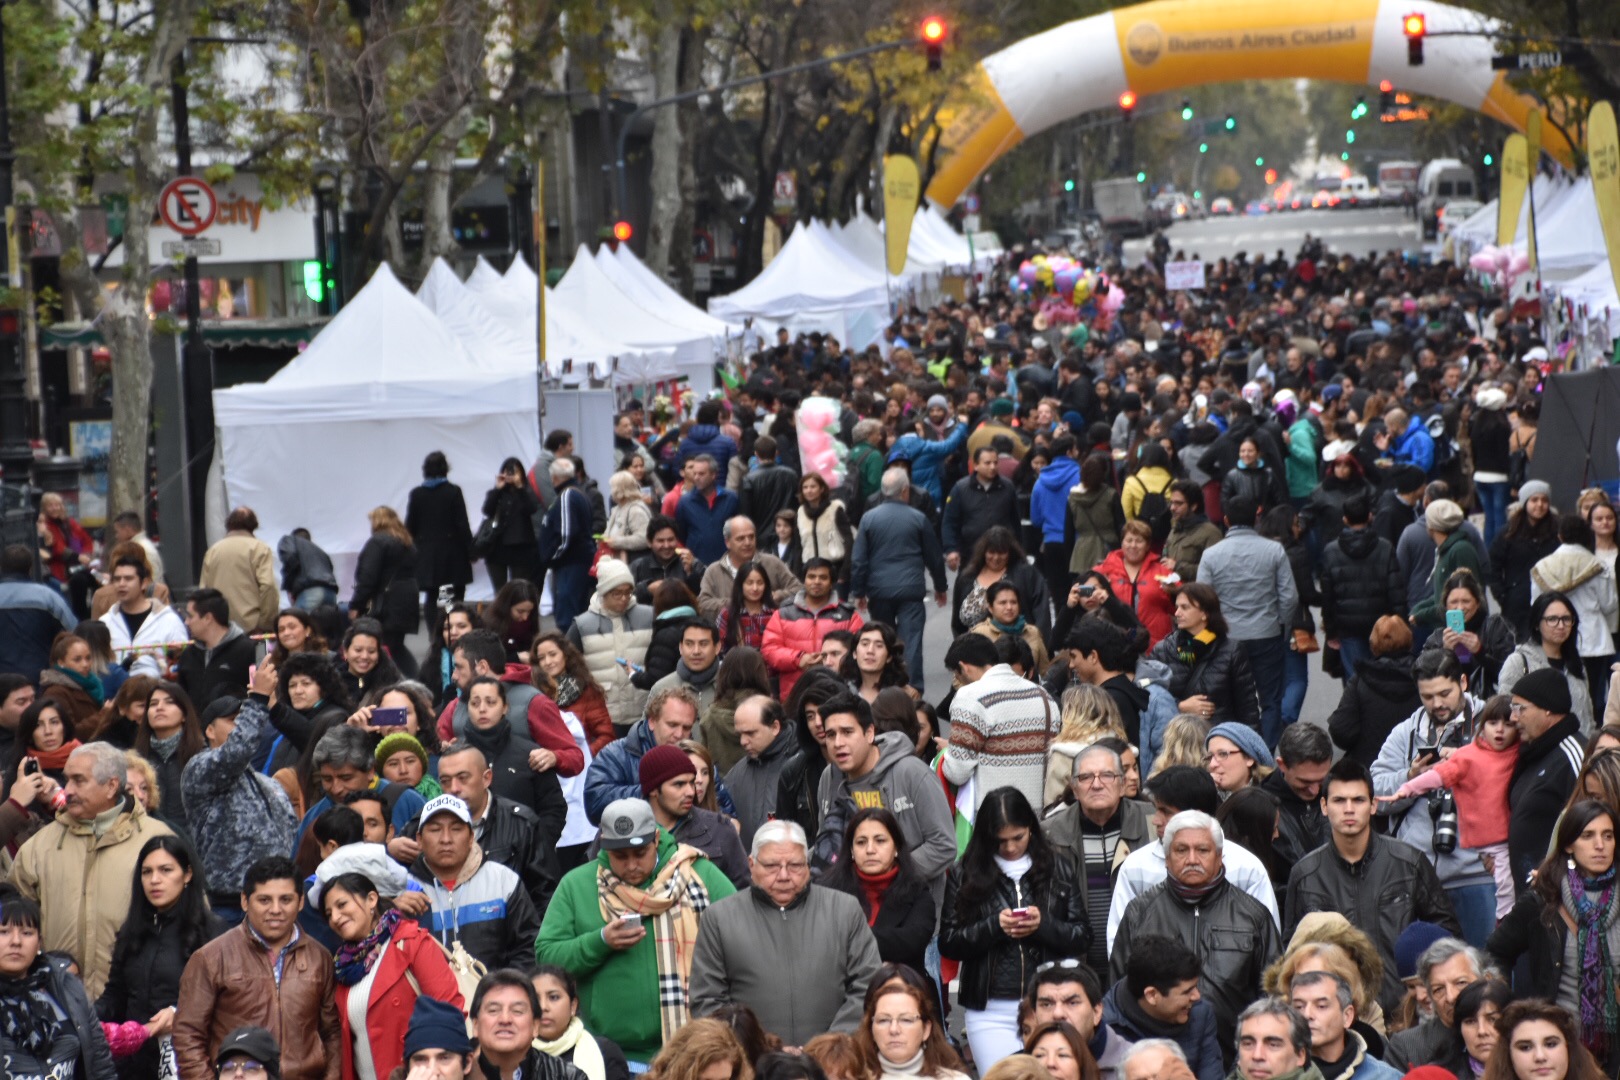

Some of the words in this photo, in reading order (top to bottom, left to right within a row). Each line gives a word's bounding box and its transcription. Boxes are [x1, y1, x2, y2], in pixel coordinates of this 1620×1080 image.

[1167, 34, 1234, 52] Buenos
[1239, 32, 1286, 49] Aires
[1290, 26, 1357, 46] Ciudad
[426, 796, 461, 811] adidas
